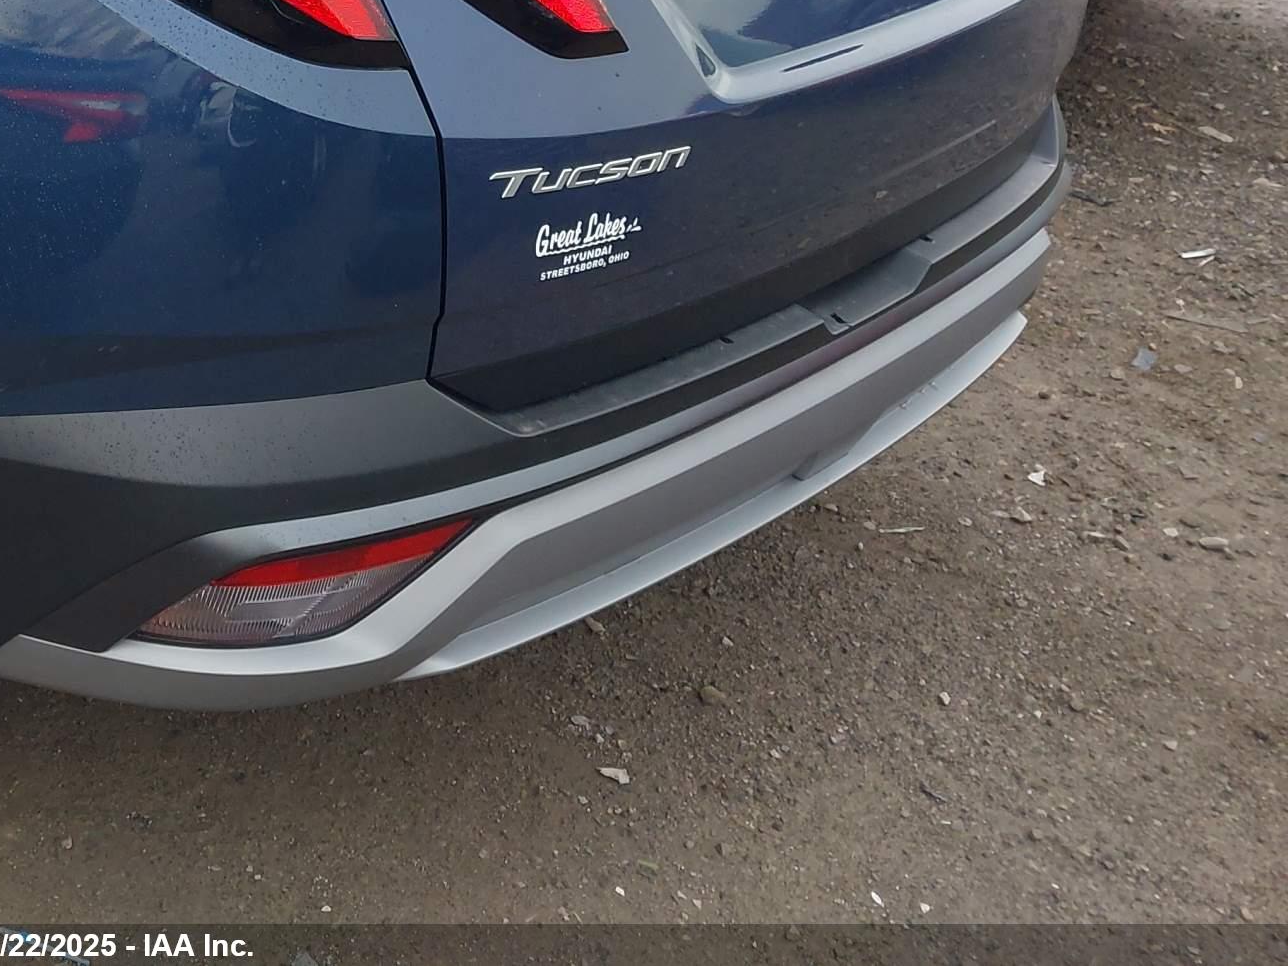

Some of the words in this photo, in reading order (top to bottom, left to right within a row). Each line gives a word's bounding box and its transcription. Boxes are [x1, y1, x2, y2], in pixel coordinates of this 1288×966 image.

[535, 220, 582, 258] Great
[583, 212, 627, 243] Lakes
[540, 257, 607, 281] STREETSBORO,
[608, 251, 630, 264] OHIO
[563, 244, 613, 266] HYUNDAI
